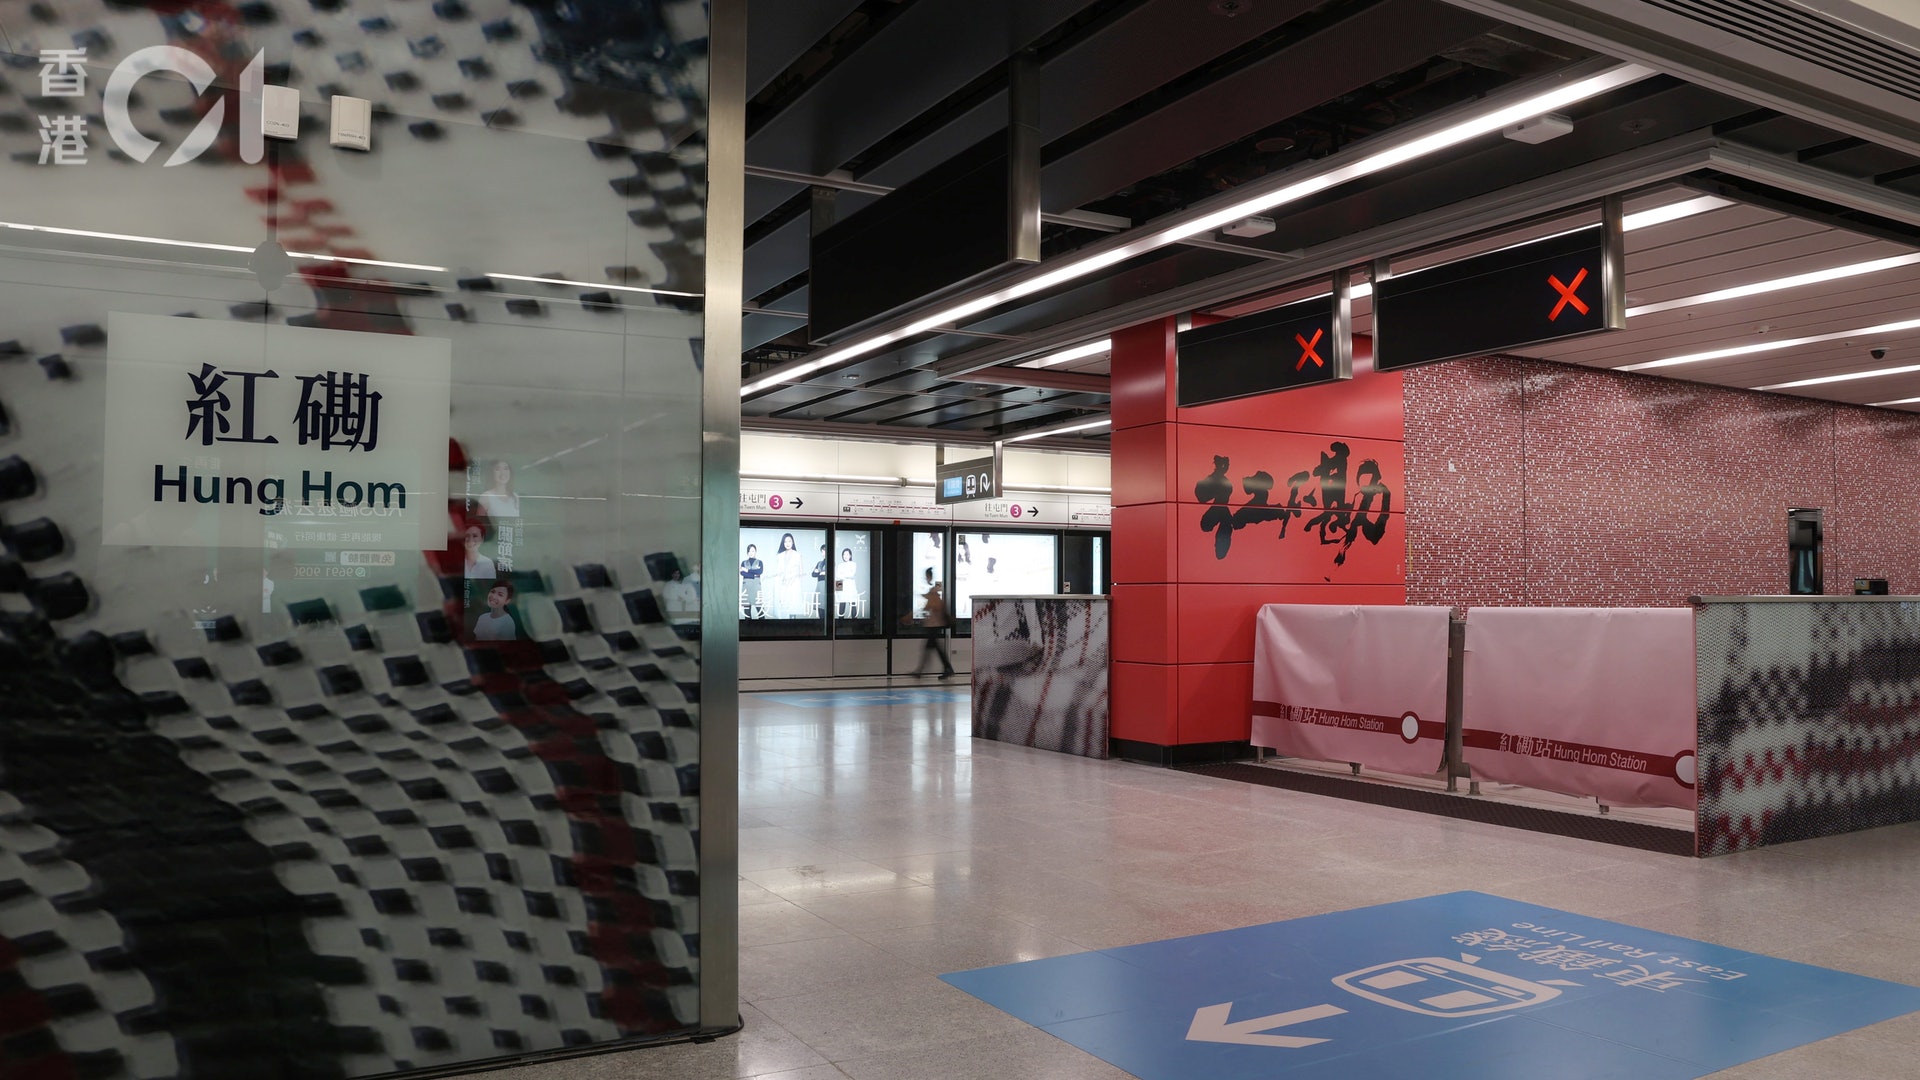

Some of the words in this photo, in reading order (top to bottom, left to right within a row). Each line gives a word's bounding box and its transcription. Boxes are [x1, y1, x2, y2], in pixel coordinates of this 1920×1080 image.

[185, 362, 383, 452] 紅磡
[154, 464, 285, 516] Hung
[302, 470, 406, 509] Hom
[1195, 442, 1391, 582] 紅磡
[1280, 703, 1319, 725] 紅磡站
[1318, 711, 1339, 728] Hung
[1340, 715, 1358, 728] Hom
[1359, 716, 1384, 732] Station
[1499, 732, 1552, 758] 紅磡站
[1553, 743, 1580, 763] Hung
[1581, 748, 1607, 766] Hom
[1609, 752, 1648, 772] Station
[1510, 920, 1586, 941] Line
[1580, 939, 1658, 961] Rail
[1657, 955, 1748, 982] East
